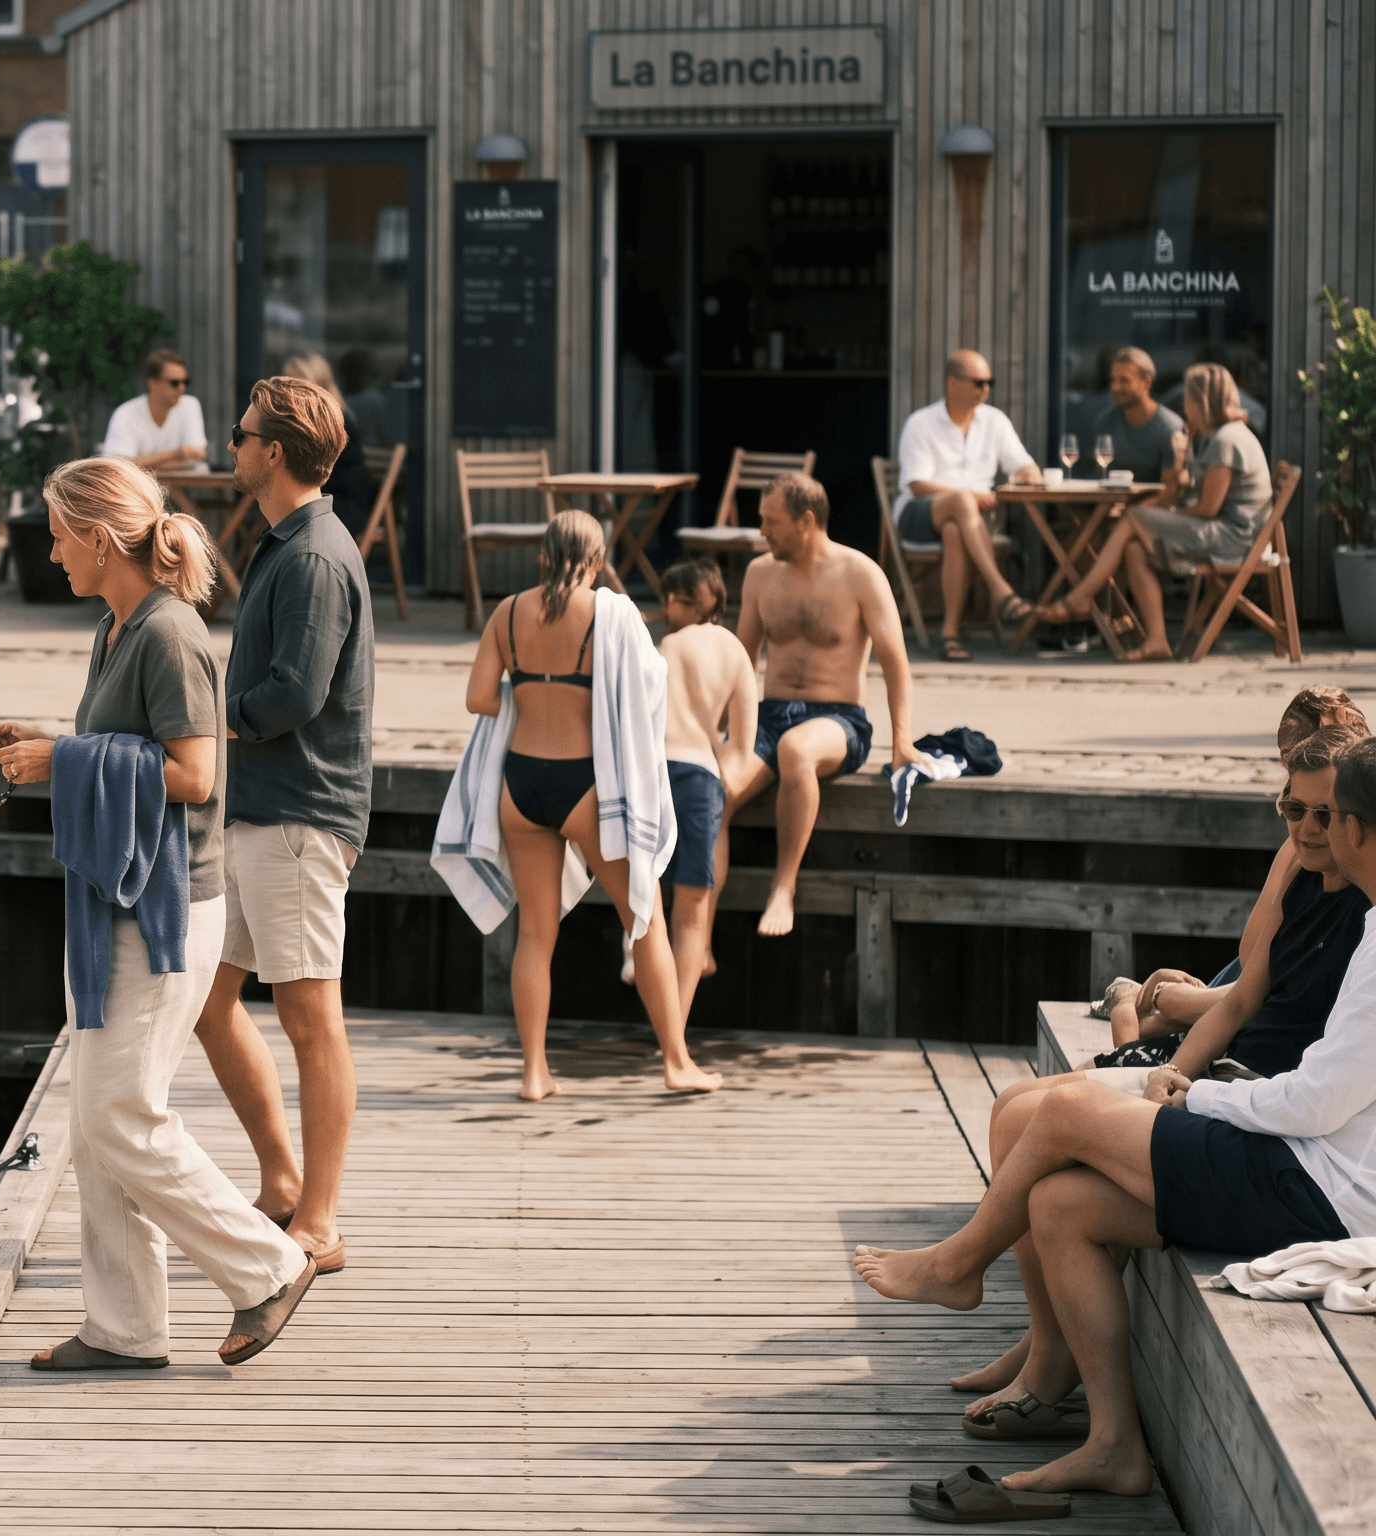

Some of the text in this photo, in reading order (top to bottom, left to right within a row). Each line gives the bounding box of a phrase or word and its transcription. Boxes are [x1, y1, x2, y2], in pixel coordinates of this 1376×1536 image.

[610, 47, 862, 87] La Banchina
[1088, 271, 1241, 293] LA BANCHINA
